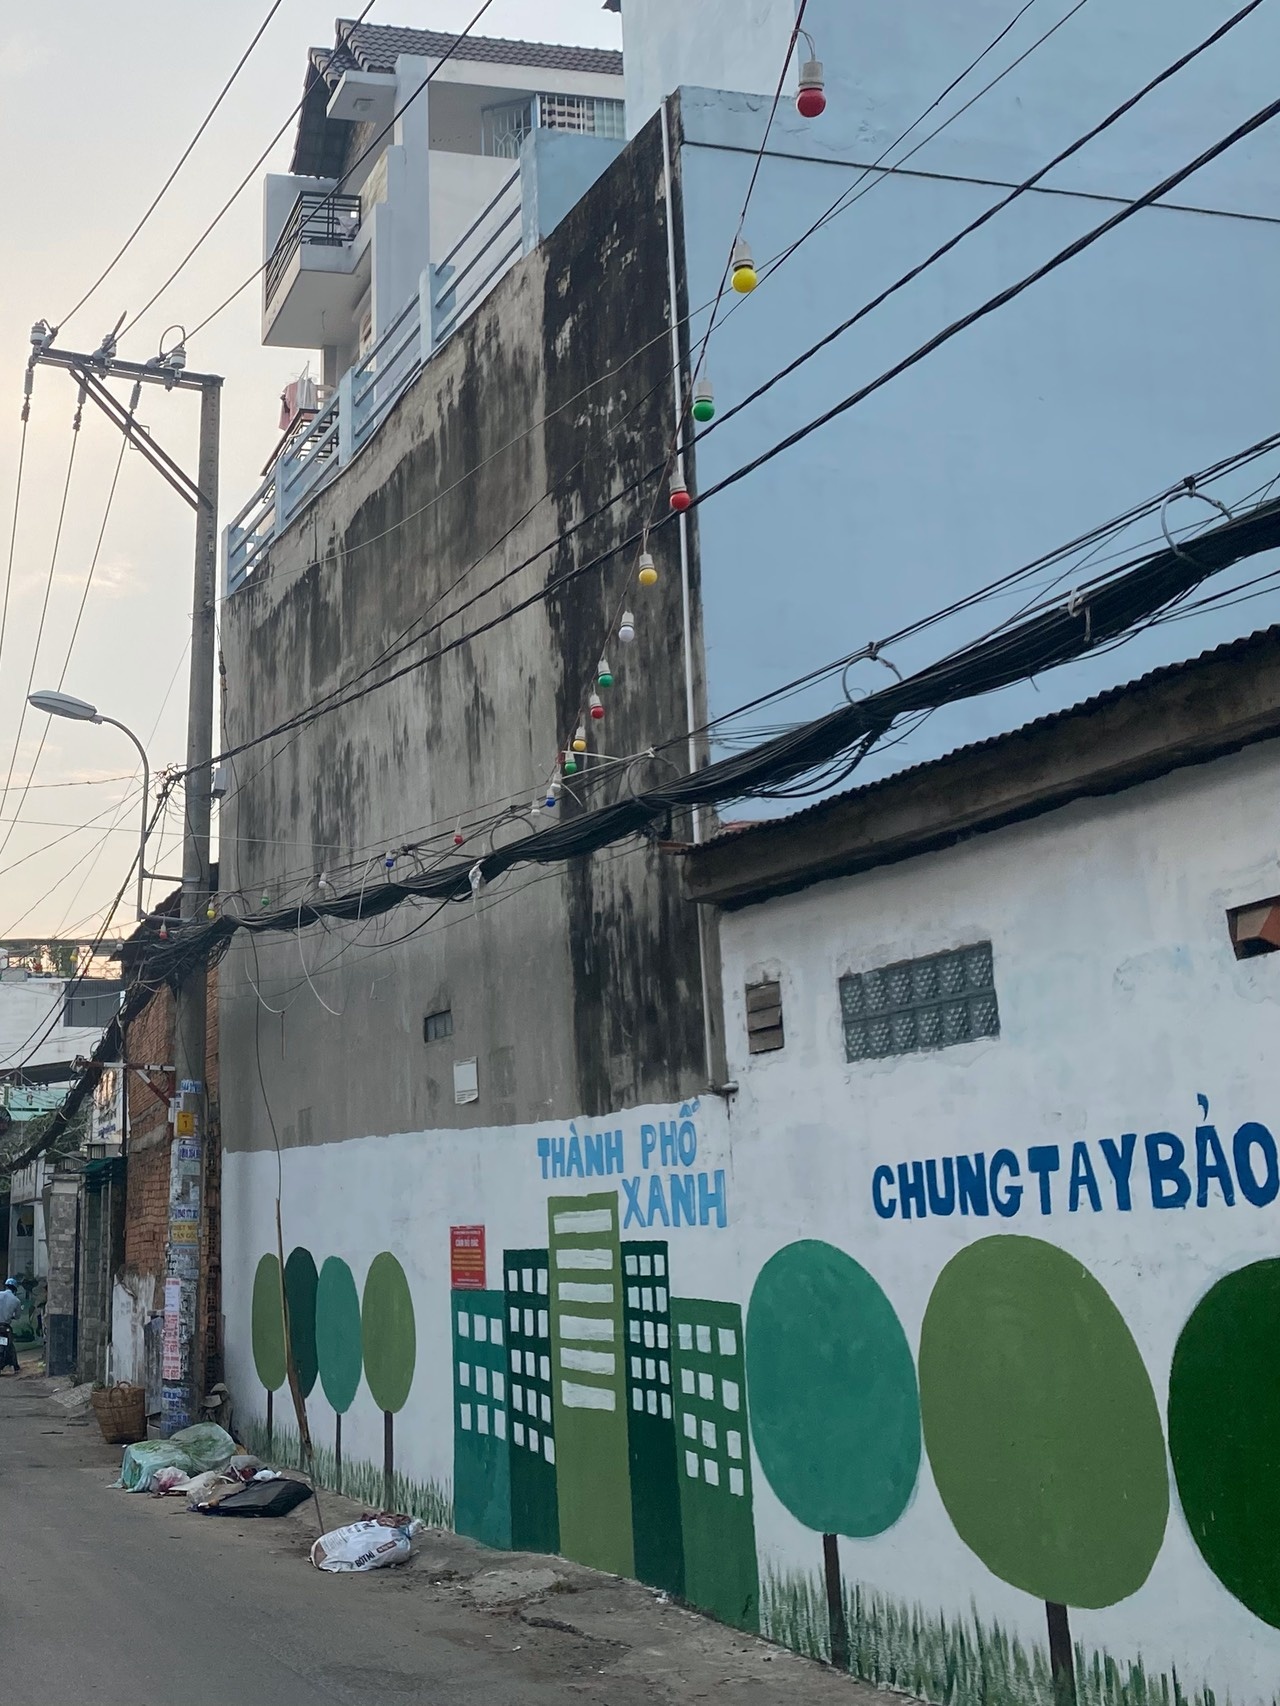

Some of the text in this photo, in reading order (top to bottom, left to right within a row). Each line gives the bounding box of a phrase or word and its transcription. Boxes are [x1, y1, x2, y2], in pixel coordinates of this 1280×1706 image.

[537, 1099, 701, 1179] THÀNH PHỐ
[872, 1093, 1279, 1219] CHUNG TAY BẢO
[621, 1169, 727, 1229] XANH
